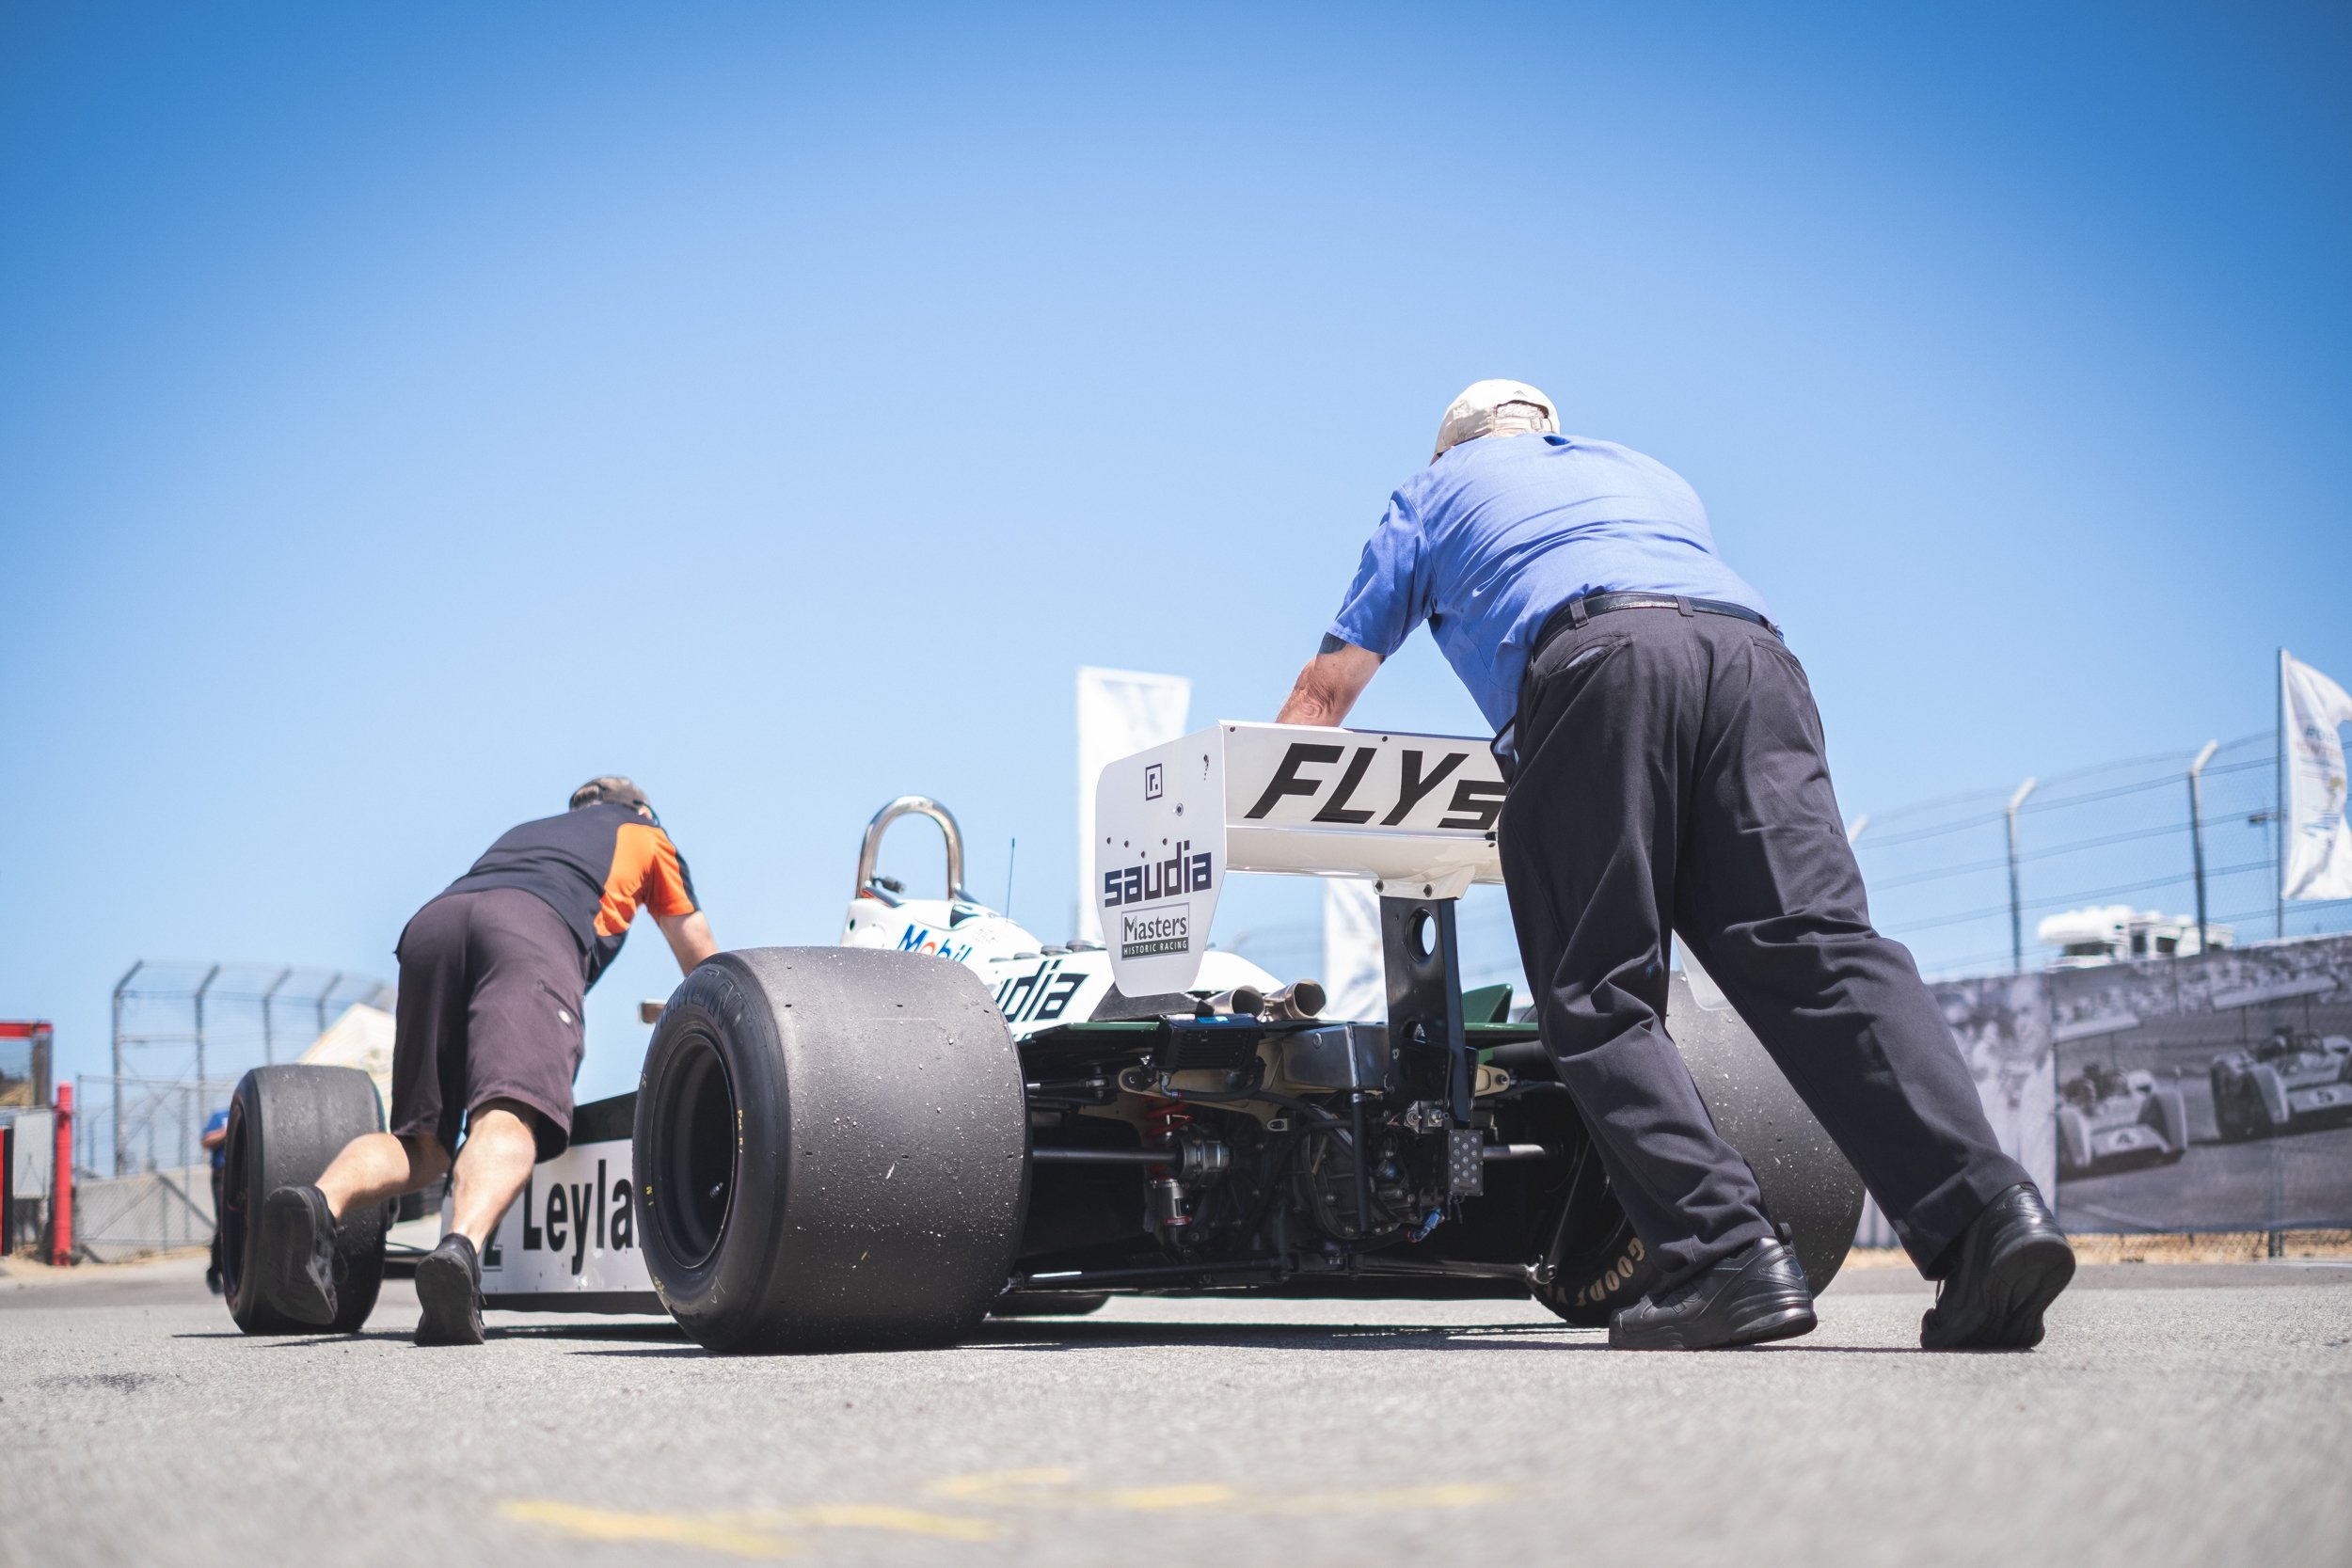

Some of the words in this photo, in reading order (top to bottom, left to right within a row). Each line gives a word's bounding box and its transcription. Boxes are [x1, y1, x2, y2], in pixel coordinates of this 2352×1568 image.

[1104, 840, 1212, 908] saudia
[1123, 915, 1187, 942] Masters
[1123, 943, 1157, 956] HISTORIC
[1159, 940, 1187, 951] RACING
[995, 959, 1090, 1022] dia
[523, 1159, 642, 1275] Leyla
